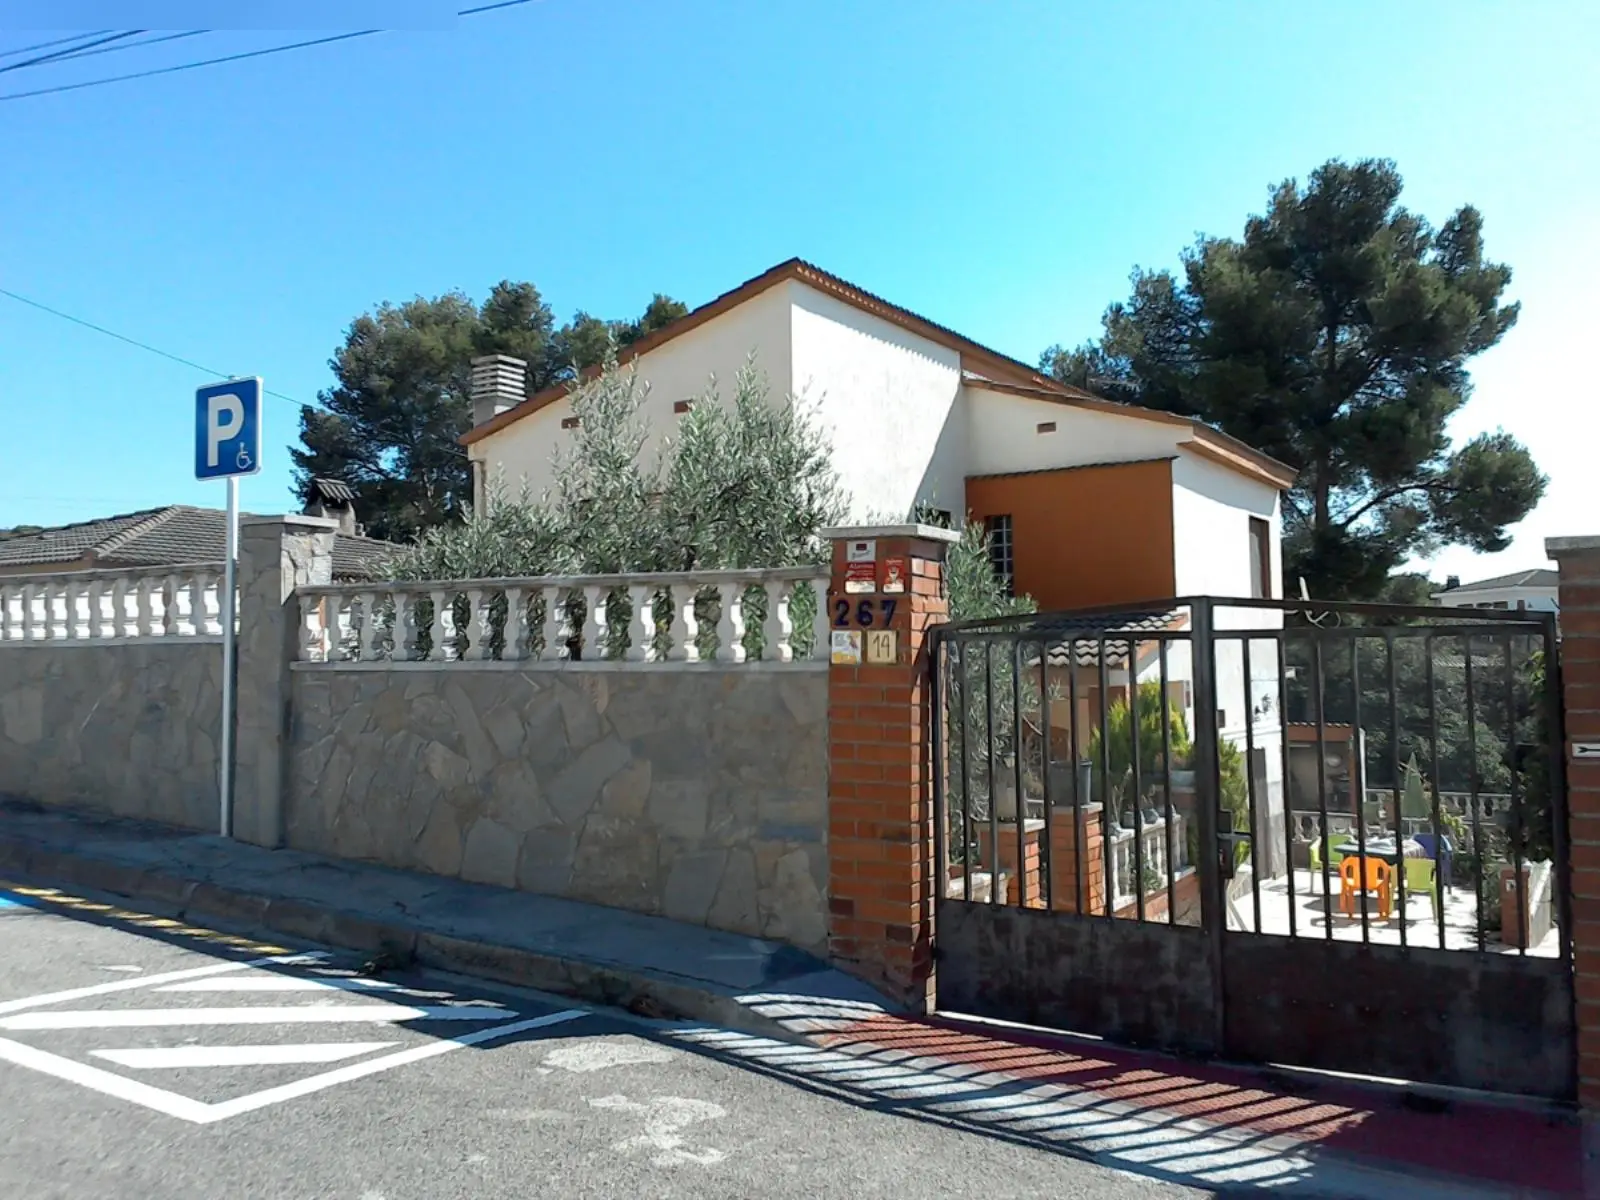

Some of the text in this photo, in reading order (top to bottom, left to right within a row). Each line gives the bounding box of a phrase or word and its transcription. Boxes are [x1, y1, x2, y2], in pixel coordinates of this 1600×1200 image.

[207, 393, 245, 468] P
[834, 599, 898, 627] 267
[872, 633, 891, 659] 14
